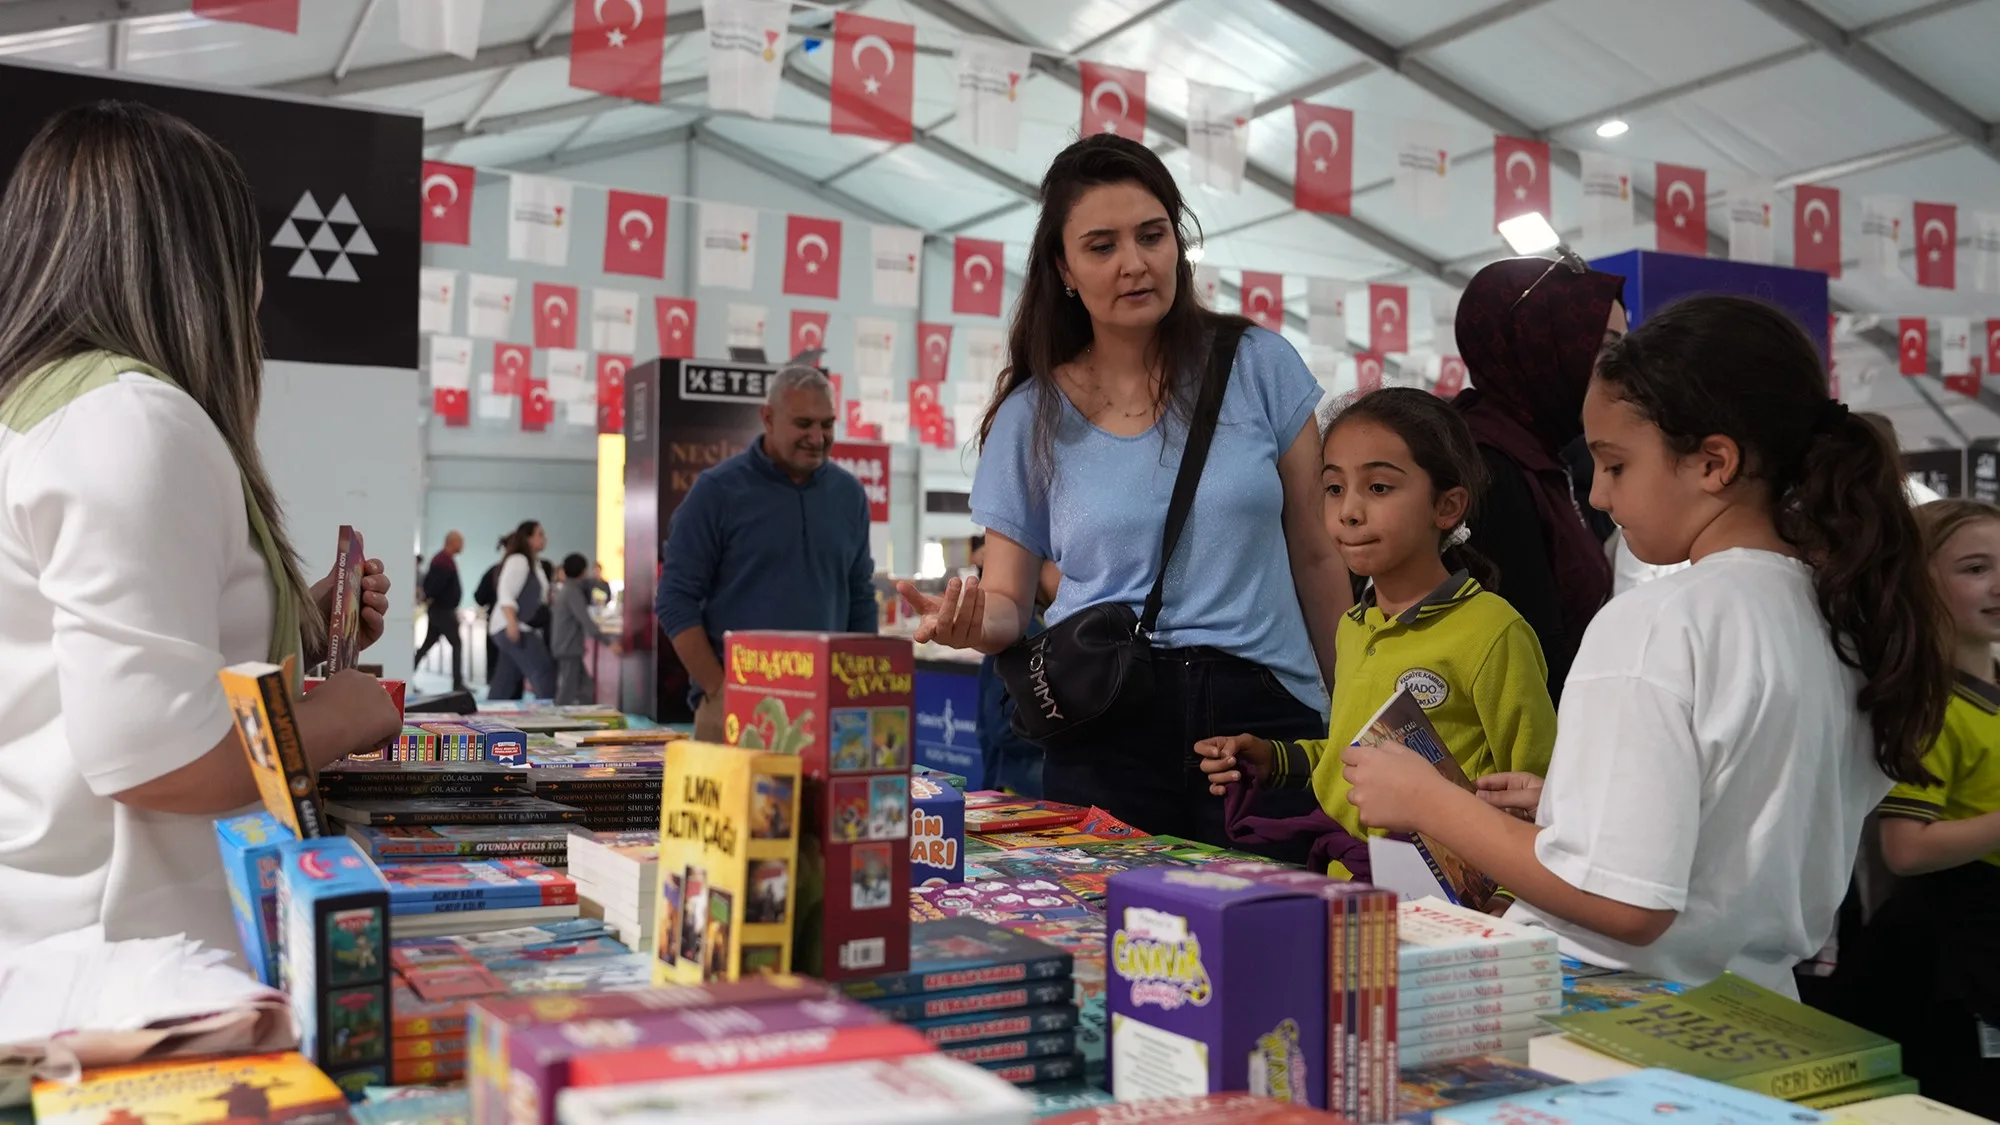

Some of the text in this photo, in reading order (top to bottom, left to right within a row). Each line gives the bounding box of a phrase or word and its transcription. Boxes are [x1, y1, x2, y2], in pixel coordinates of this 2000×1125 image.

[1030, 632, 1064, 719] TOMMY
[1405, 682, 1437, 694] MADO
[442, 774, 456, 783] ÇÖL
[457, 774, 483, 782] ASLANI
[430, 785, 444, 794] ÇÖL
[628, 804, 654, 812] SİMURG
[498, 812, 518, 820] KURT
[519, 811, 547, 820] KAPANI
[627, 815, 653, 823] SİMURG
[914, 811, 941, 837] İN
[476, 842, 521, 852] OYUNDAN
[521, 841, 546, 852] ÇIKIŞ
[911, 840, 955, 866] ARI
[1470, 946, 1500, 960] Nutuk
[1469, 965, 1498, 979] Nutuk
[1475, 984, 1503, 997] Nutuk
[1473, 1001, 1502, 1015] Nutuk
[1472, 1019, 1501, 1033] Nutuk
[1473, 1038, 1502, 1051] Nutuk
[1770, 1059, 1859, 1098] GERİ SAYIM
